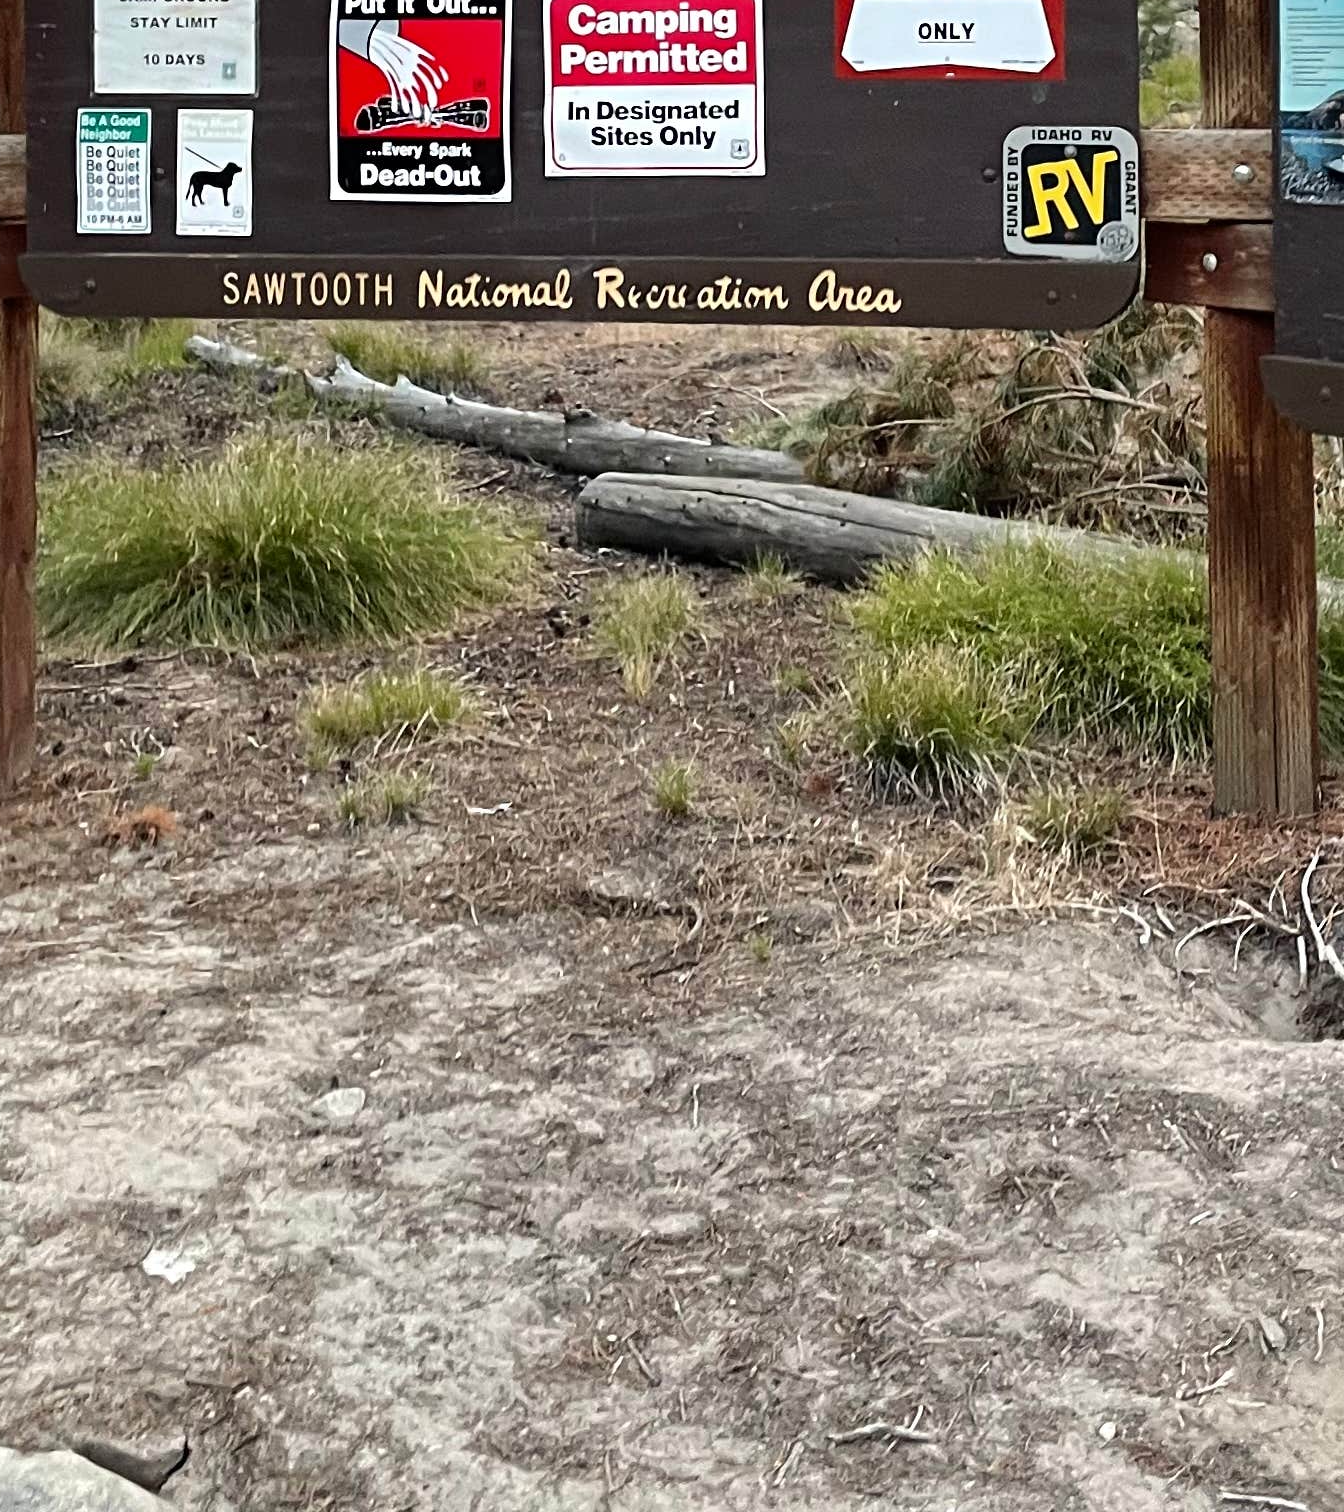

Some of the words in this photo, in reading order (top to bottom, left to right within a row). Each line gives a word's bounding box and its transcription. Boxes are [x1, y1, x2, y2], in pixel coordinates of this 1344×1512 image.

[130, 17, 171, 28] STAY
[175, 17, 218, 28] LIMIT
[568, 1, 737, 39] Camping
[918, 22, 975, 40] ONLY
[143, 54, 160, 65] 10
[165, 54, 205, 65] DAYS
[560, 41, 748, 74] Permitted
[81, 114, 96, 127] Be
[99, 115, 107, 127] A
[110, 114, 141, 127] Good
[568, 101, 590, 120] In
[597, 100, 739, 124] Designated
[81, 128, 131, 142] Neighbor
[591, 126, 653, 146] Sites
[660, 126, 716, 149] Only
[1032, 129, 1082, 141] IDAHO
[1091, 130, 1112, 141] RV
[87, 146, 102, 158] Be
[106, 146, 140, 160] Quiet
[429, 142, 472, 160] Spark
[1008, 147, 1018, 165] BY
[87, 159, 102, 171] Be
[106, 159, 140, 173] Quiet
[360, 163, 481, 187] Dead-Out
[87, 173, 102, 185] Be
[106, 173, 140, 187] Quiet
[1125, 161, 1136, 215] GRANT
[87, 187, 102, 198] Be
[106, 187, 140, 200] Quiet
[1024, 151, 1118, 238] RV
[1007, 172, 1019, 236] FUNDED
[127, 215, 142, 224] AM
[222, 271, 393, 306] SAWTOOTH
[417, 268, 572, 309] National
[808, 269, 902, 313] Area
